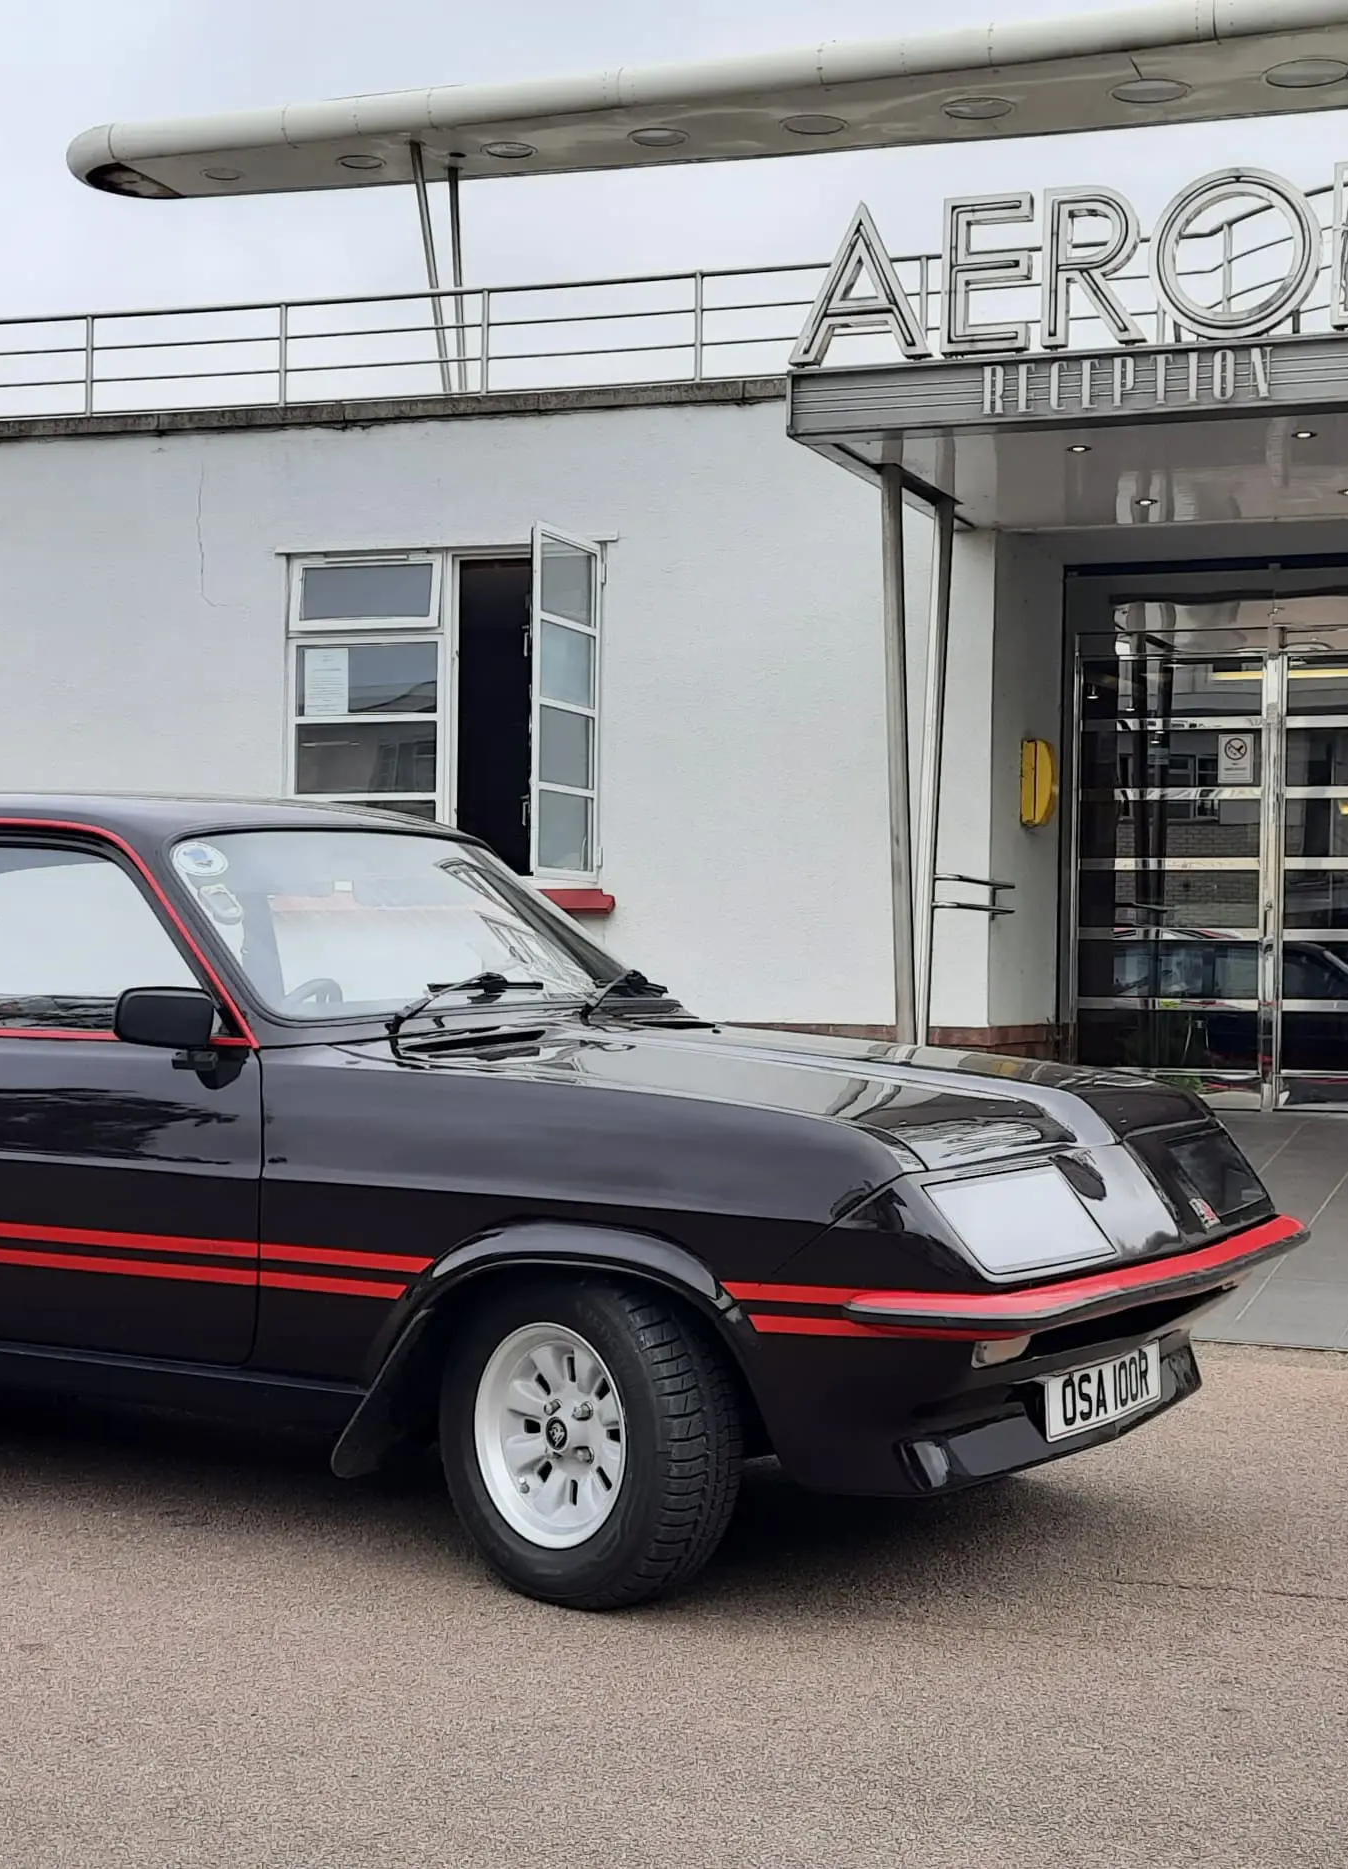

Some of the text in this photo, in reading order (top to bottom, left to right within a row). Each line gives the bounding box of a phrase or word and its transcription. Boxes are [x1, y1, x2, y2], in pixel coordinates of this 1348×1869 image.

[981, 345, 1274, 415] RECEPTION
[1061, 1348, 1150, 1427] OSA 100R
